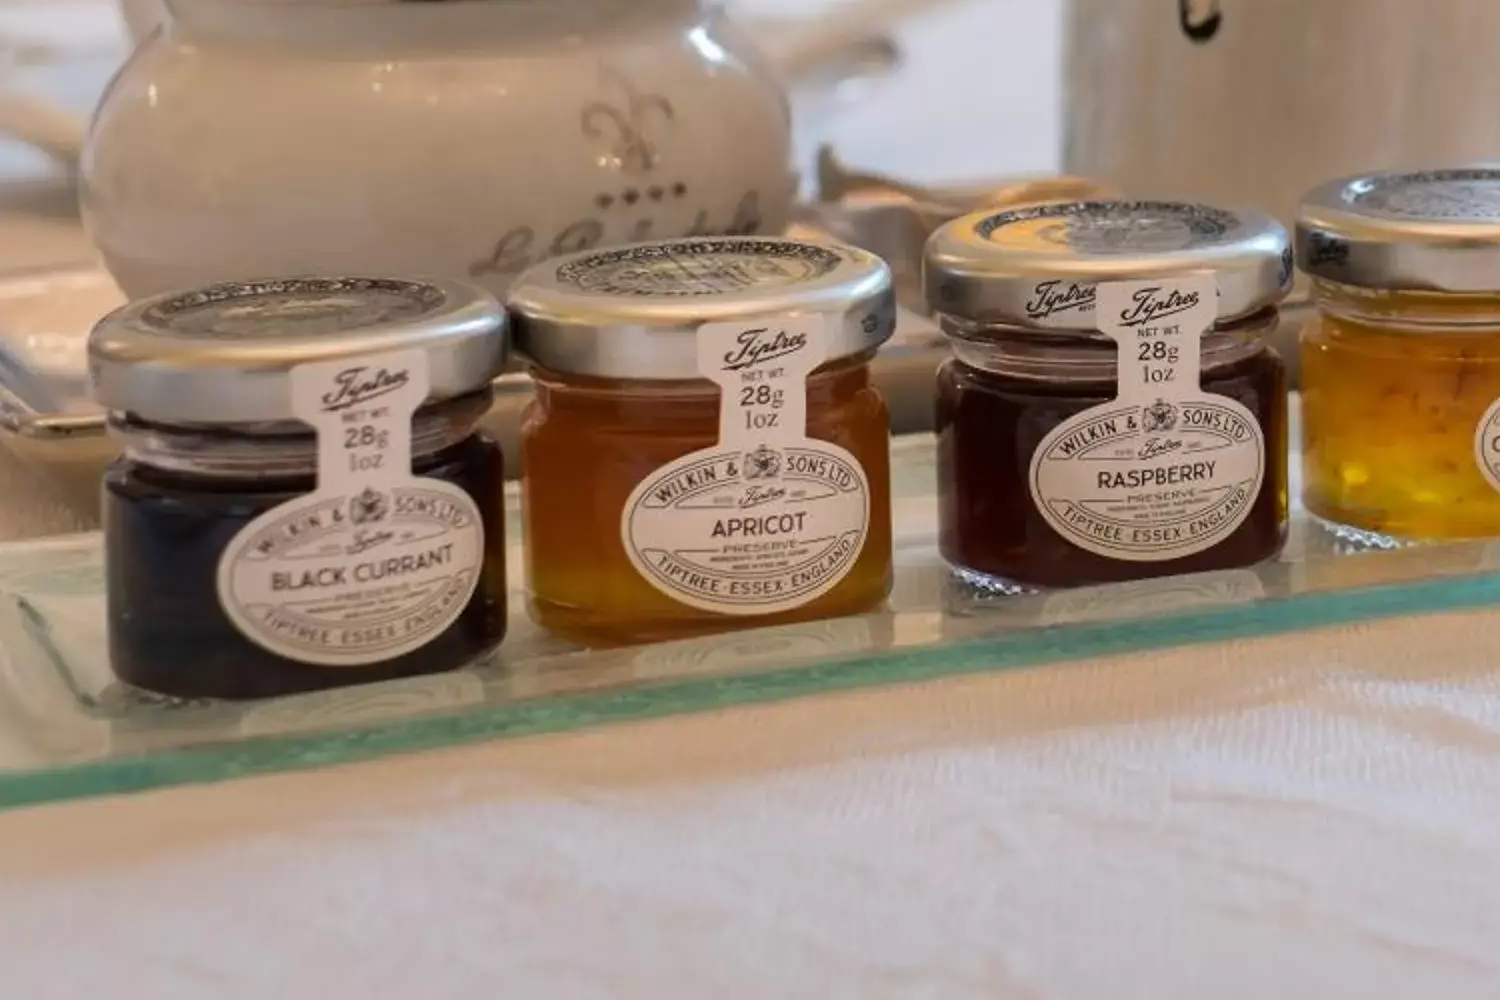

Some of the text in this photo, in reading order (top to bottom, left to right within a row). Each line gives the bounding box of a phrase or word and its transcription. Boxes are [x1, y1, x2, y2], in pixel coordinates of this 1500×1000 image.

[1118, 287, 1200, 327] Tiptree
[1137, 328, 1159, 337] NET
[721, 328, 807, 370] Tiptree
[1137, 341, 1179, 362] 28g
[742, 371, 764, 381] NET
[1143, 366, 1176, 383] 1oz
[740, 386, 784, 408] 28g
[745, 413, 779, 429] 1oz
[1060, 409, 1246, 454] WILKIN & SONS LTD
[344, 425, 390, 449] 28g
[350, 454, 384, 472] 1oz
[1097, 460, 1217, 489] RASPBERRY
[655, 456, 852, 502] WILKIN & SONS LTD
[711, 511, 808, 538] APRICOT
[1062, 489, 1247, 542] TIPTREE ESSEX ENGLAND
[271, 544, 454, 591] BLACK CURRANT
[657, 538, 851, 595] TIPTREE ESSEX ENGLAND
